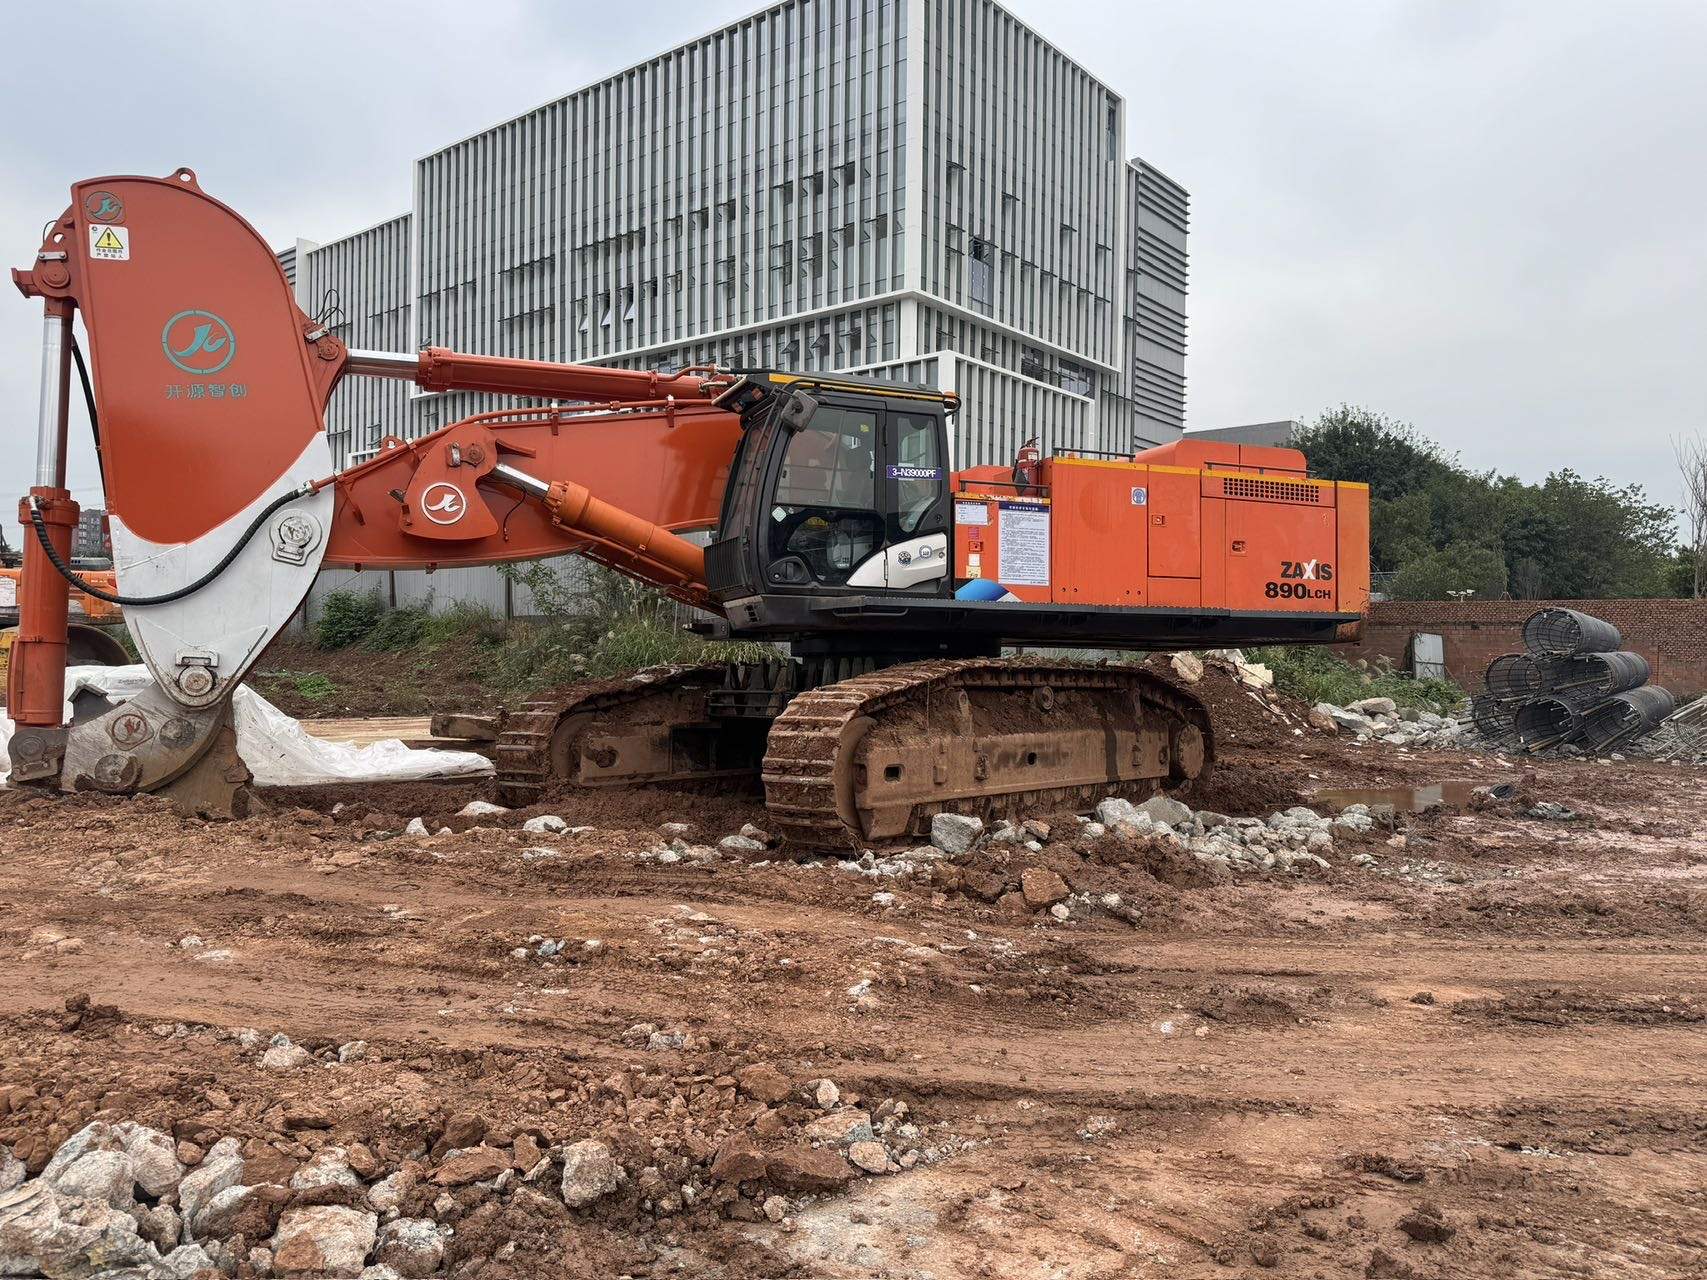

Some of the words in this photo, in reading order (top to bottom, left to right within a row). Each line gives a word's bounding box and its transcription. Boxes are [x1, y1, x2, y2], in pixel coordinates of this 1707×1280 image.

[165, 384, 247, 400] 开源智创
[892, 467, 936, 478] 3-N39000PF
[1280, 559, 1333, 580] ZAXIS
